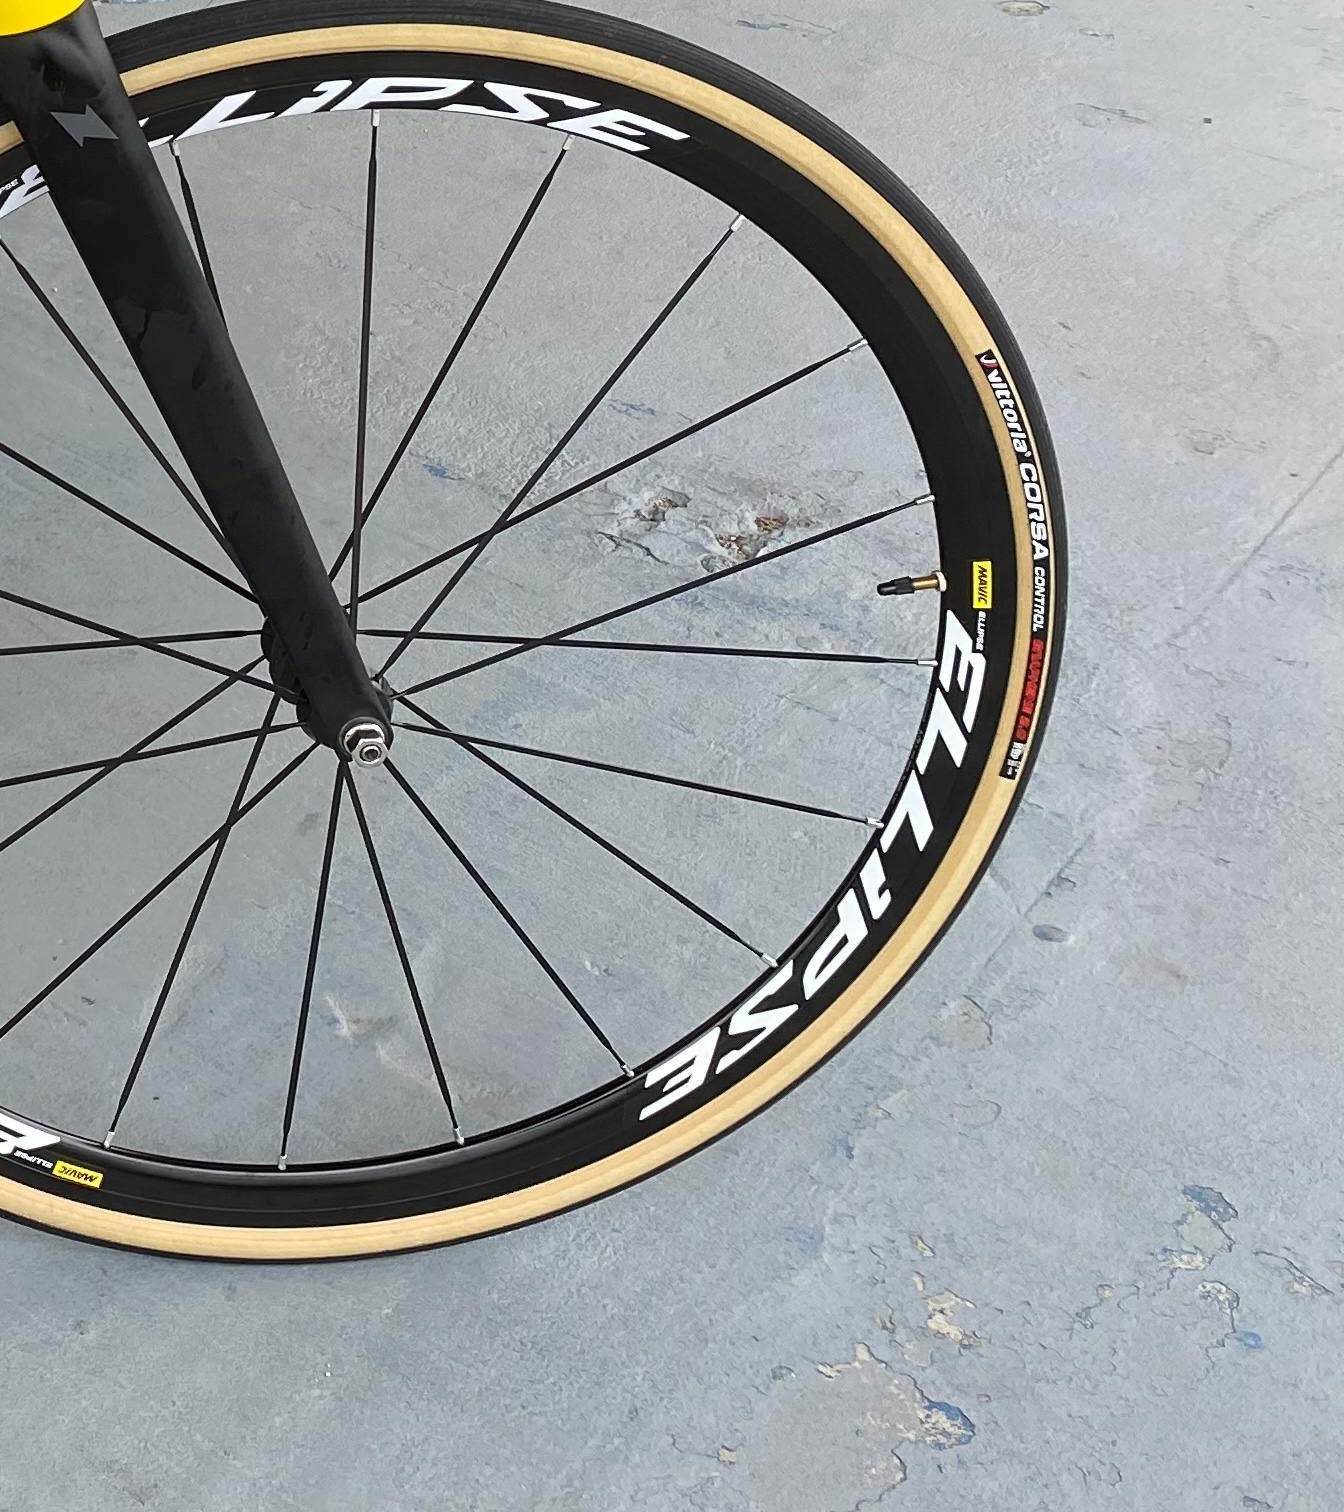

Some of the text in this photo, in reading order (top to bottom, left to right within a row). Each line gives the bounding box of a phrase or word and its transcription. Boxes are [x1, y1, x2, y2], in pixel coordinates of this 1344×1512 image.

[988, 367, 1031, 455] vittoria
[1018, 461, 1050, 562] CORSA
[1030, 564, 1049, 632] CONTROL
[638, 564, 988, 1121] MAVIC ELLIPSE ELLIPSE
[57, 1164, 99, 1185] MAVIC
